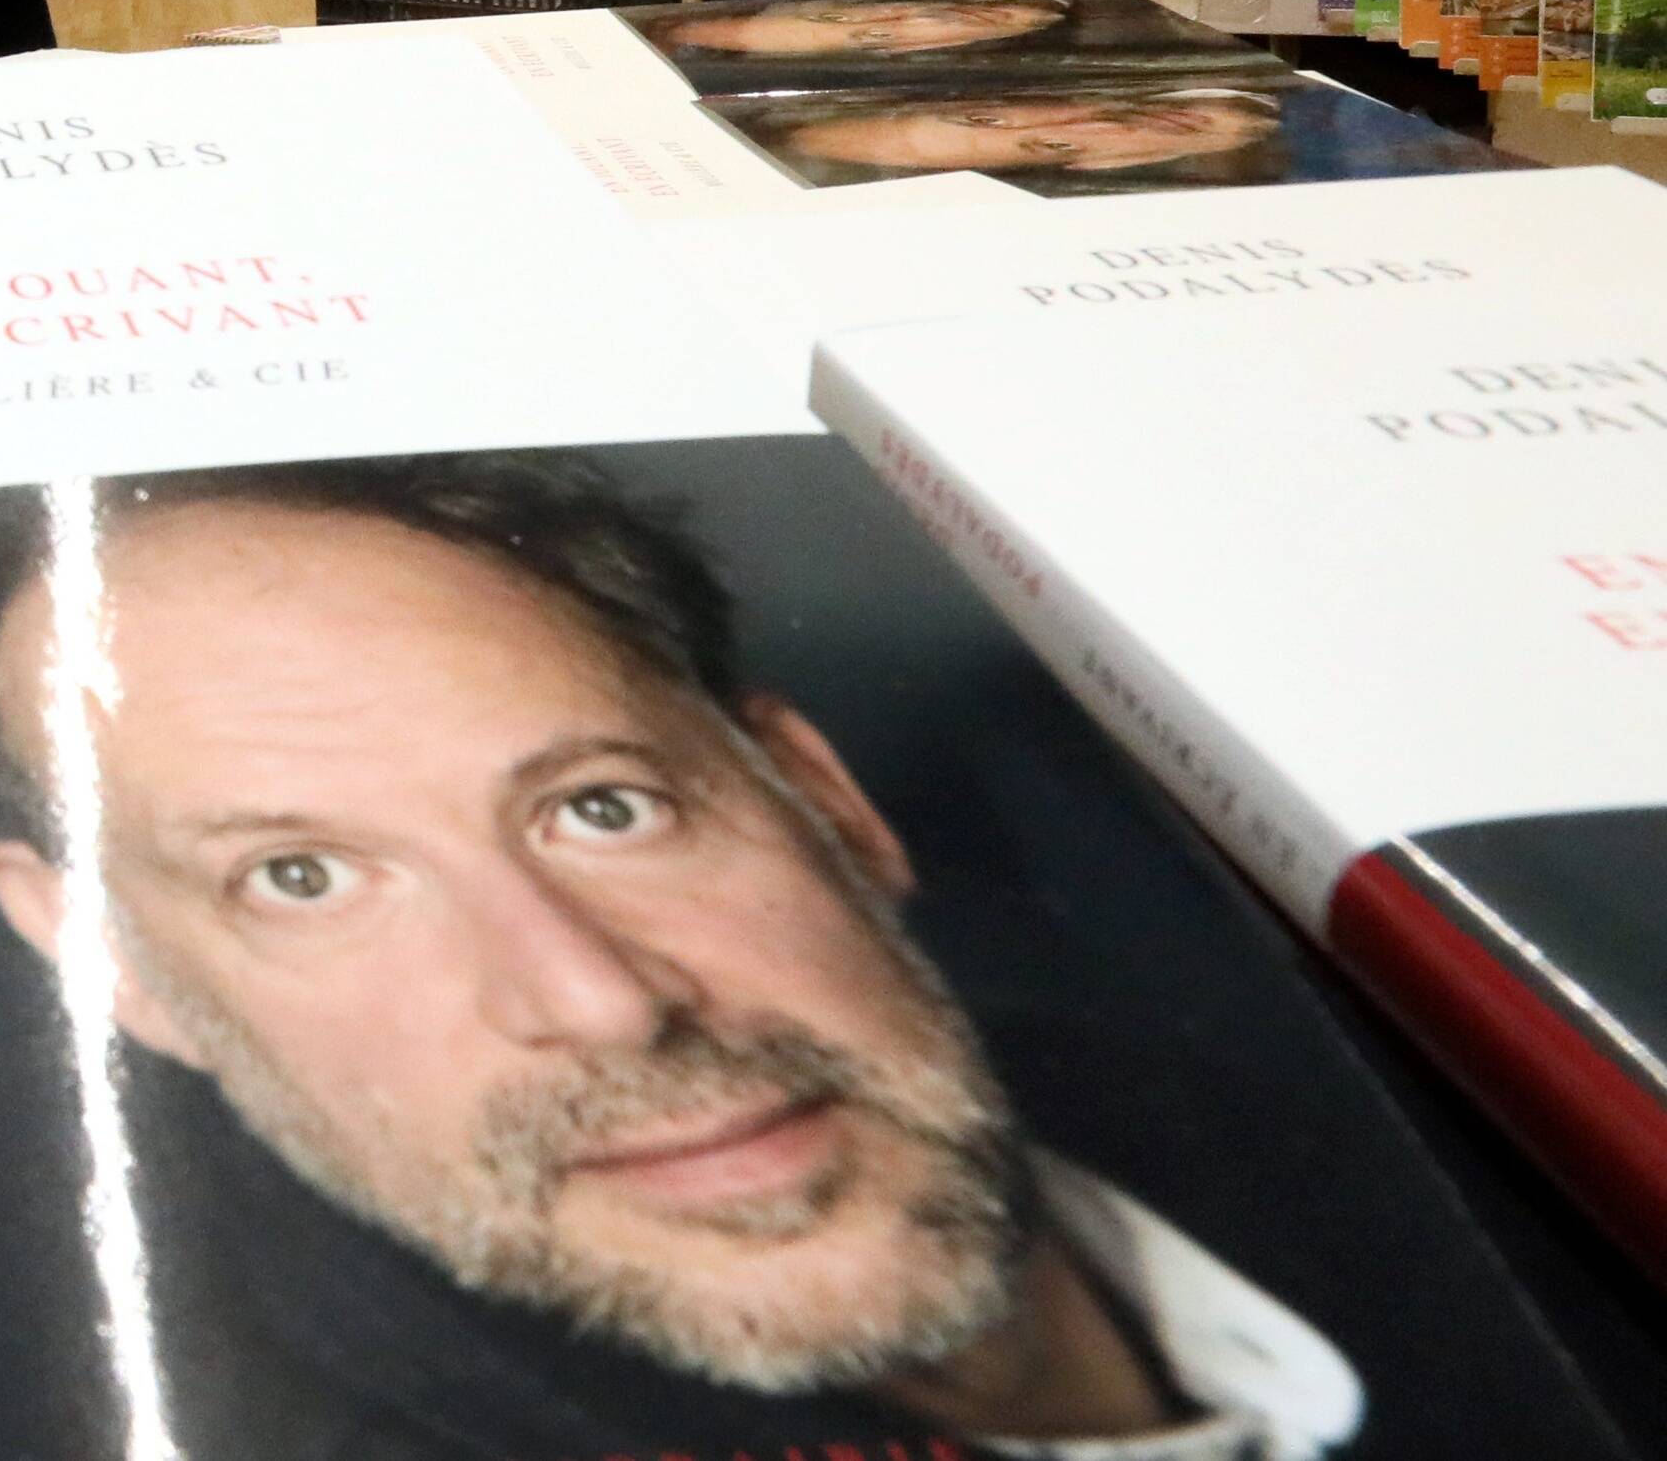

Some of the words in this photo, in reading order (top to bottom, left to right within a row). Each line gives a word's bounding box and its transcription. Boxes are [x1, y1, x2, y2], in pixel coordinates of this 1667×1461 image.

[1087, 238, 1307, 272] DENIS
[1019, 257, 1471, 307] PODALYDÈS
[188, 368, 219, 389] &
[253, 358, 352, 386] CIE
